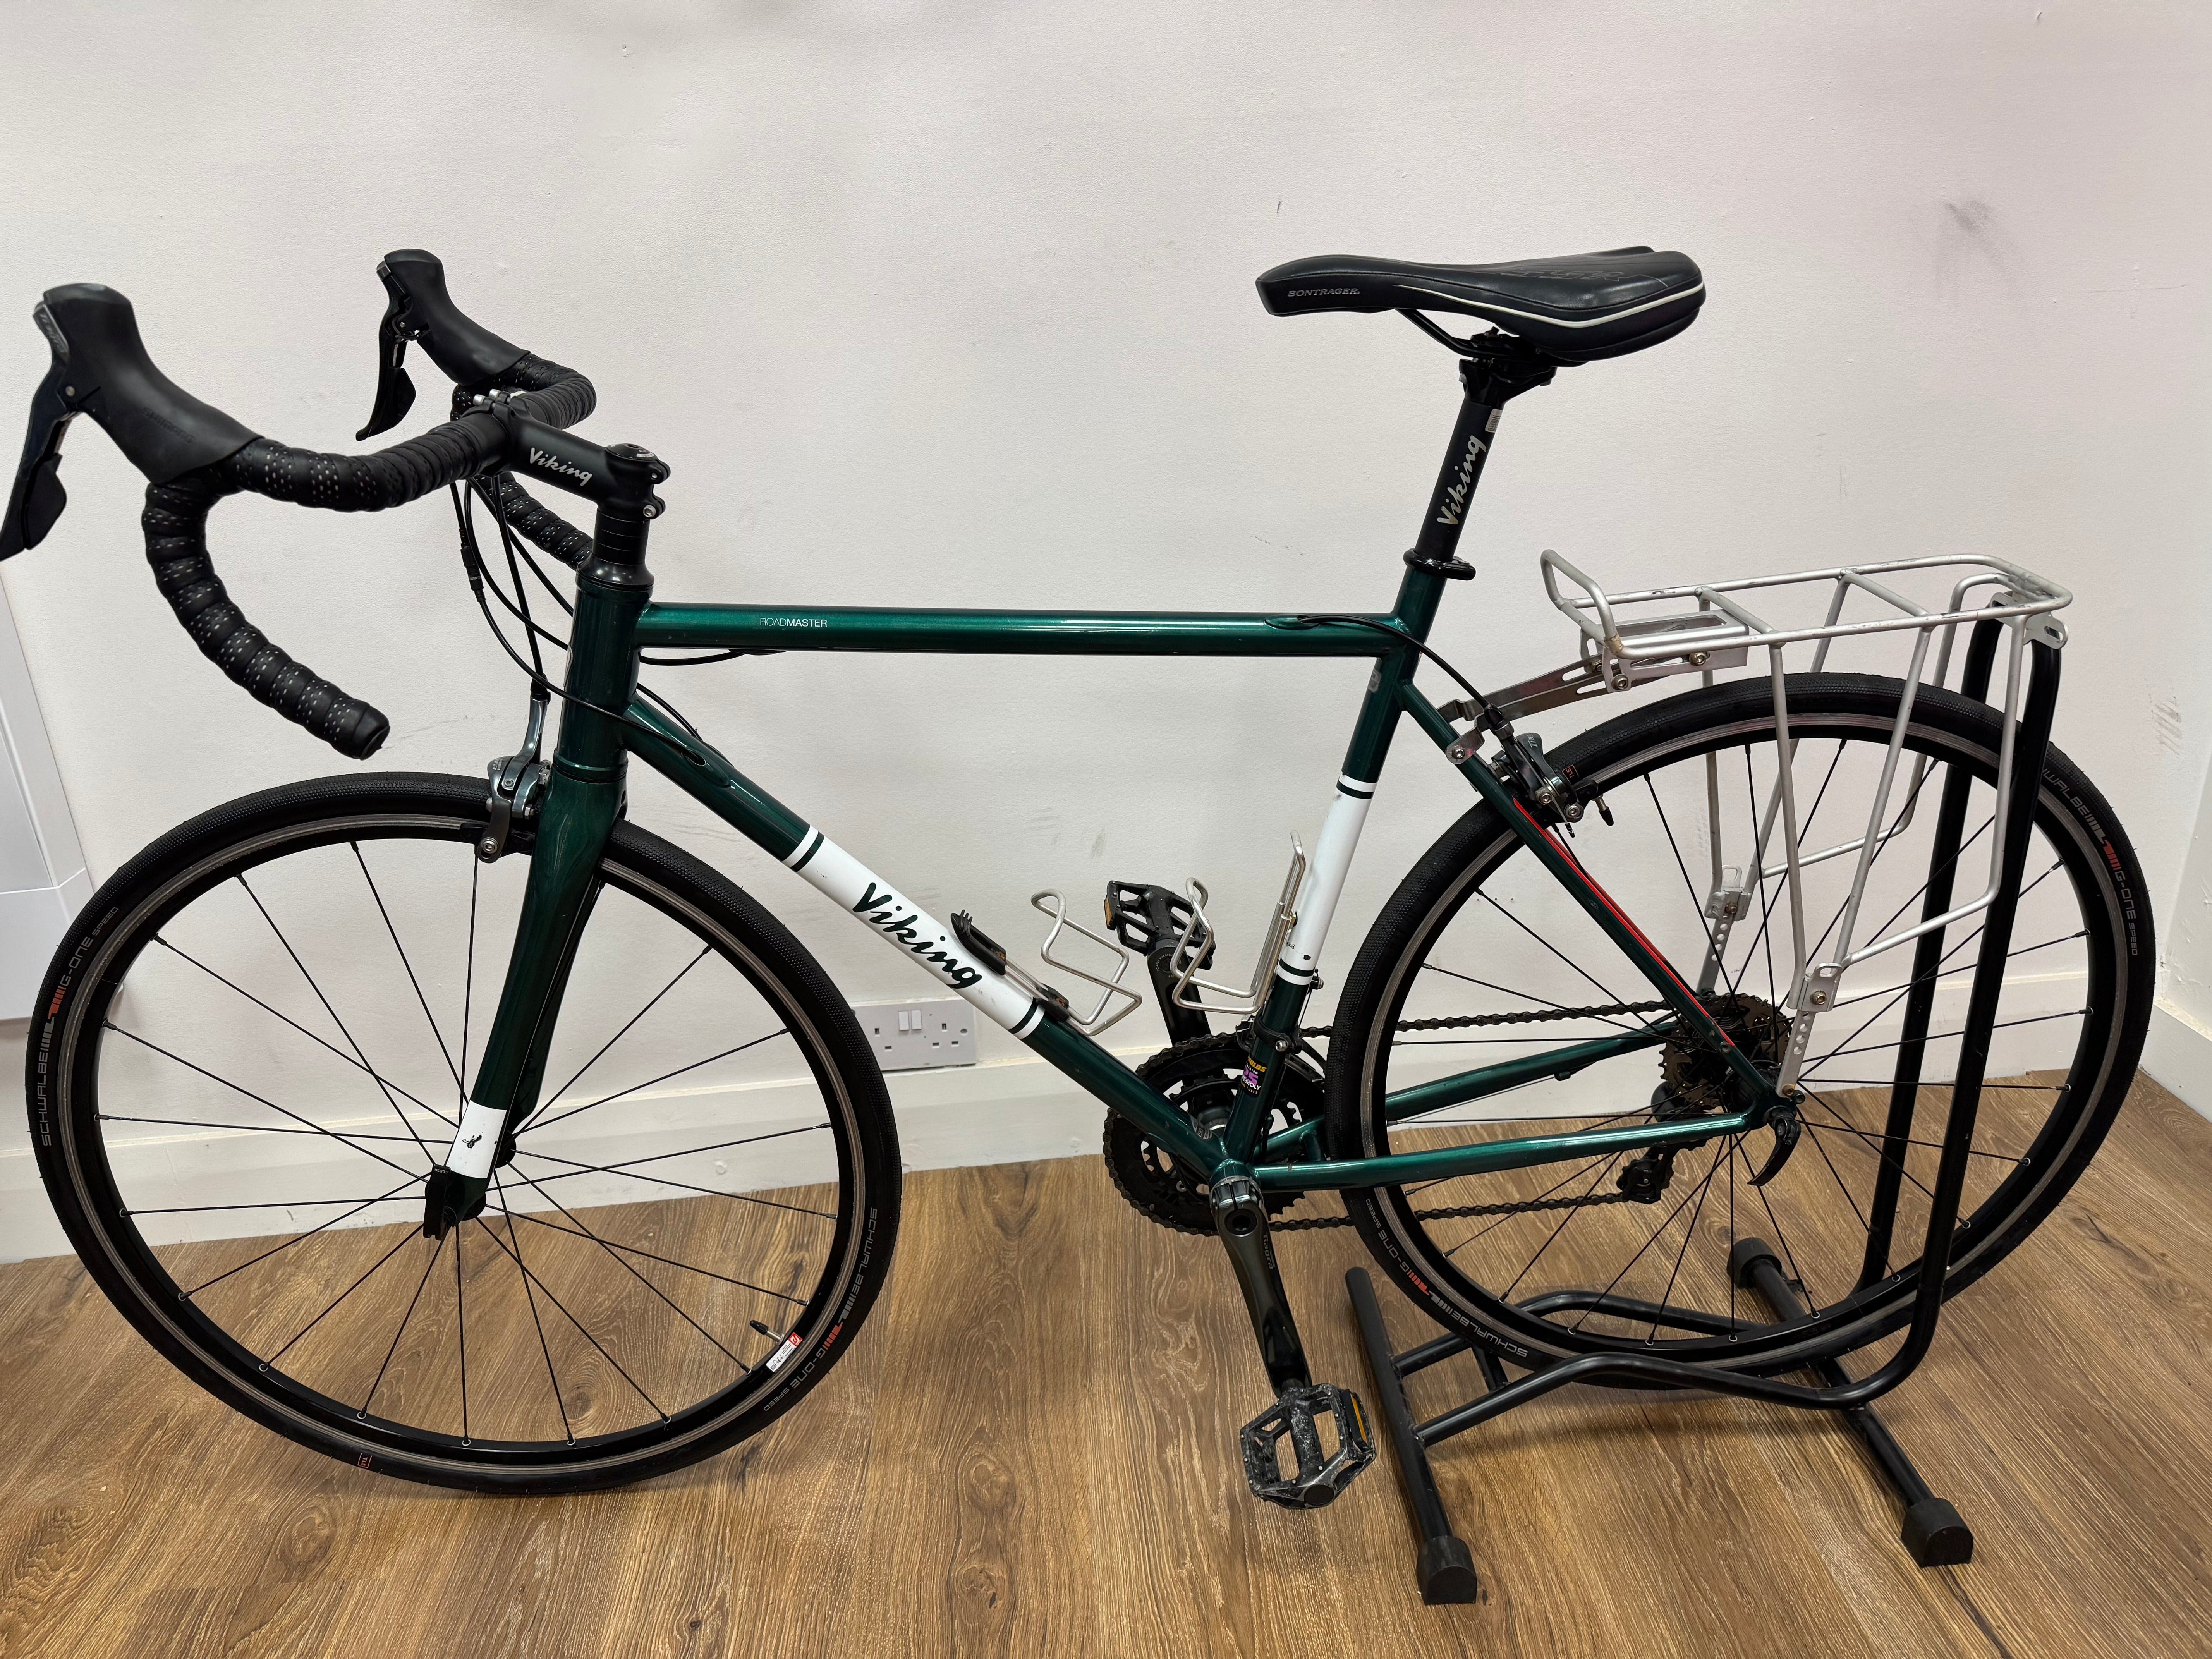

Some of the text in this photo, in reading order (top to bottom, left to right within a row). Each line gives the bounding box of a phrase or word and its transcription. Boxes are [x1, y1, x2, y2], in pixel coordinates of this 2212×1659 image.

[1287, 288, 1360, 297] BONTRAGER
[529, 447, 592, 486] Viking
[1437, 435, 1487, 525] Viking
[760, 618, 828, 627] ROADMASTER
[852, 882, 982, 989] Viking
[2129, 923, 2137, 956] SPEED
[37, 1051, 51, 1146] SCHWALBE
[93, 907, 118, 936] SPEED
[1366, 1199, 1381, 1228] SPEED
[852, 1207, 878, 1294] SCHWALBE
[1451, 1311, 1528, 1357] SCHWALBE
[764, 1387, 790, 1411] SPEED
